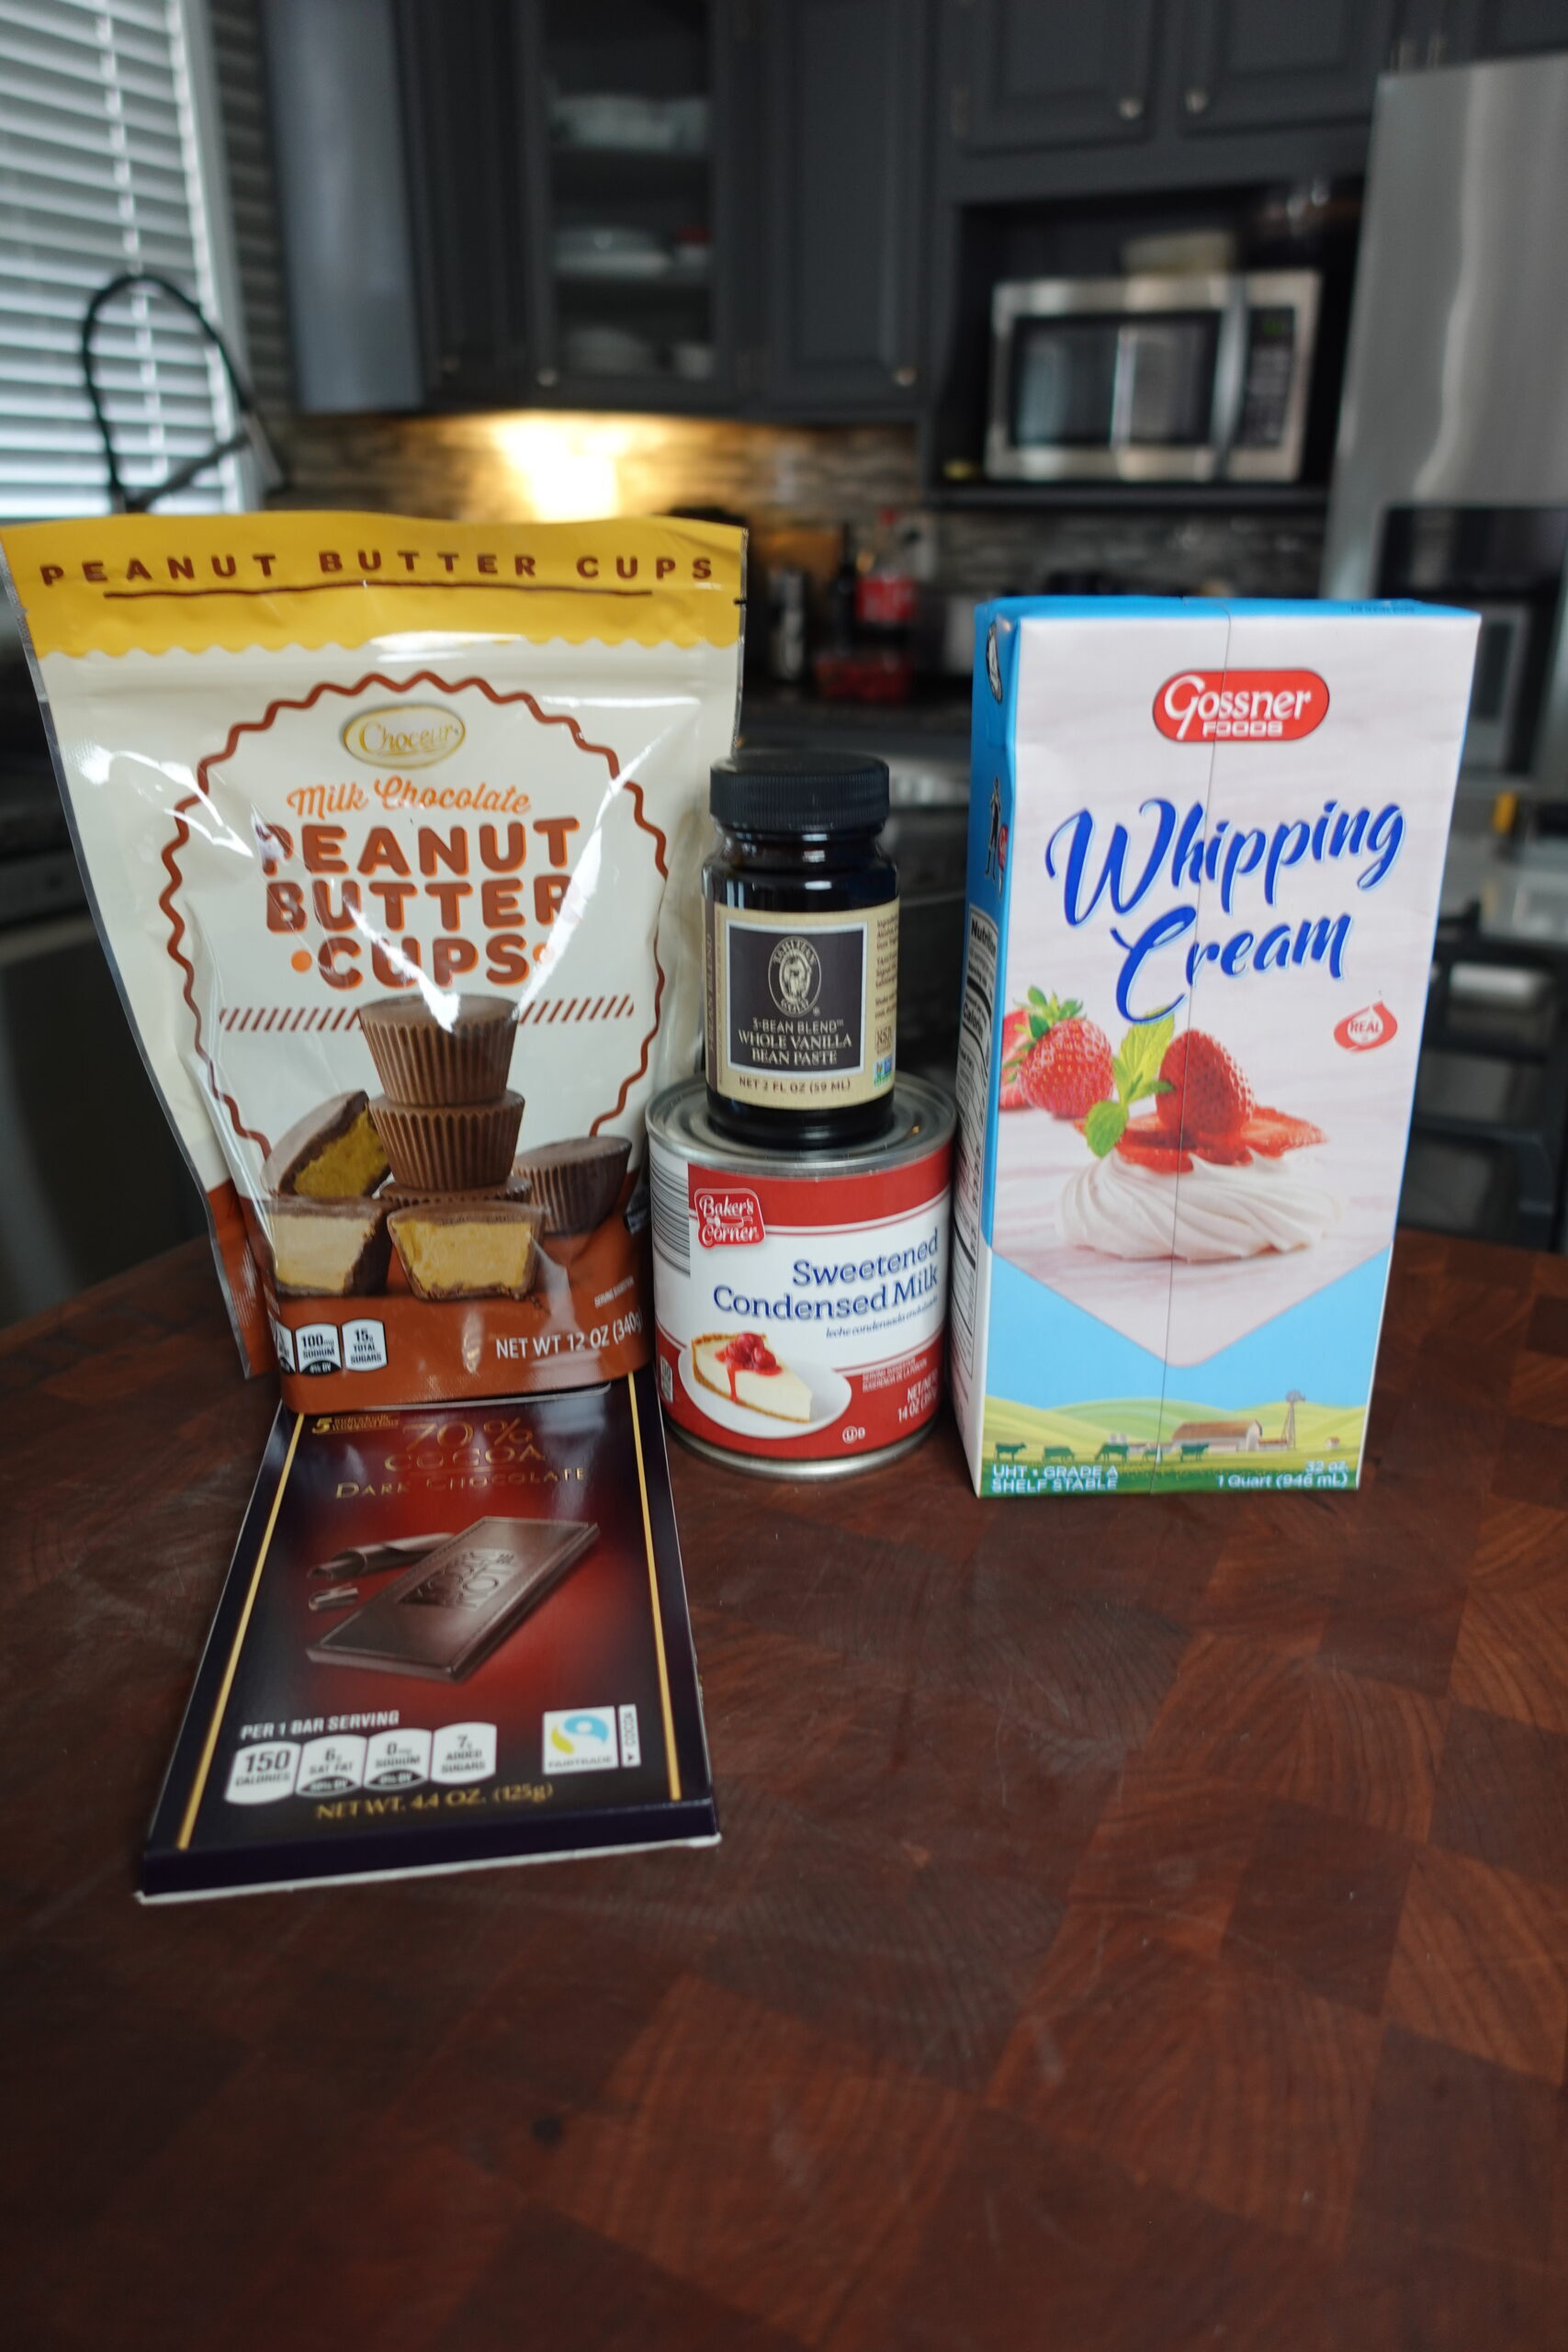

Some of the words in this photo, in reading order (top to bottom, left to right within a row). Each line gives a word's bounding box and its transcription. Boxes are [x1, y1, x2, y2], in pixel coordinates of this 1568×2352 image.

[39, 554, 277, 586] PEANUT
[320, 548, 538, 580] BUTTER
[576, 556, 715, 582] CUPS
[1163, 674, 1313, 740] Gossner
[358, 719, 455, 757] Choceur
[1202, 720, 1284, 738] FOODS
[286, 782, 369, 820] Milk
[373, 775, 532, 815] Chocolate
[257, 816, 581, 877] PEANUT
[1045, 797, 1405, 926] Whipping
[265, 874, 581, 933] BUTTER
[318, 933, 530, 989] CUPS
[1110, 904, 1352, 1025] Cream
[752, 1017, 794, 1034] 3-BEAN
[738, 1029, 787, 1049] WHOLE
[789, 1032, 852, 1050] VANILLA
[751, 1047, 790, 1065] BEAN
[793, 1049, 838, 1066] PASTE
[739, 1076, 760, 1091] NET
[762, 1080, 770, 1091] 2
[772, 1080, 787, 1093] FL
[789, 1080, 807, 1095] OZ
[809, 1080, 828, 1095] (59
[698, 1194, 755, 1219] Baker's
[701, 1225, 758, 1247] Corner
[792, 1227, 939, 1287] Sweetened
[712, 1283, 887, 1321] Condensed
[891, 1264, 939, 1305] Milk
[496, 1336, 529, 1360] NET
[532, 1333, 562, 1357] WT
[566, 1331, 586, 1353] 12
[590, 1324, 611, 1350] OZ
[312, 1417, 333, 1433] 5
[897, 1405, 908, 1424] 14
[384, 1443, 547, 1472] COCOA
[992, 1462, 1028, 1478] UHT
[1043, 1464, 1102, 1479] GRADE
[1106, 1464, 1119, 1478] A
[1217, 1474, 1224, 1488] 1
[1227, 1474, 1272, 1488] Quart
[1275, 1472, 1314, 1490] (946
[335, 1481, 412, 1499] DARK
[991, 1477, 1047, 1494] SHELF
[1052, 1476, 1118, 1492] STABLE
[240, 1722, 275, 1741] PER
[278, 1721, 288, 1737] 1
[290, 1716, 325, 1736] BAR
[327, 1709, 400, 1732] SERVING
[245, 1749, 291, 1773] 150
[317, 1800, 361, 1820] NET
